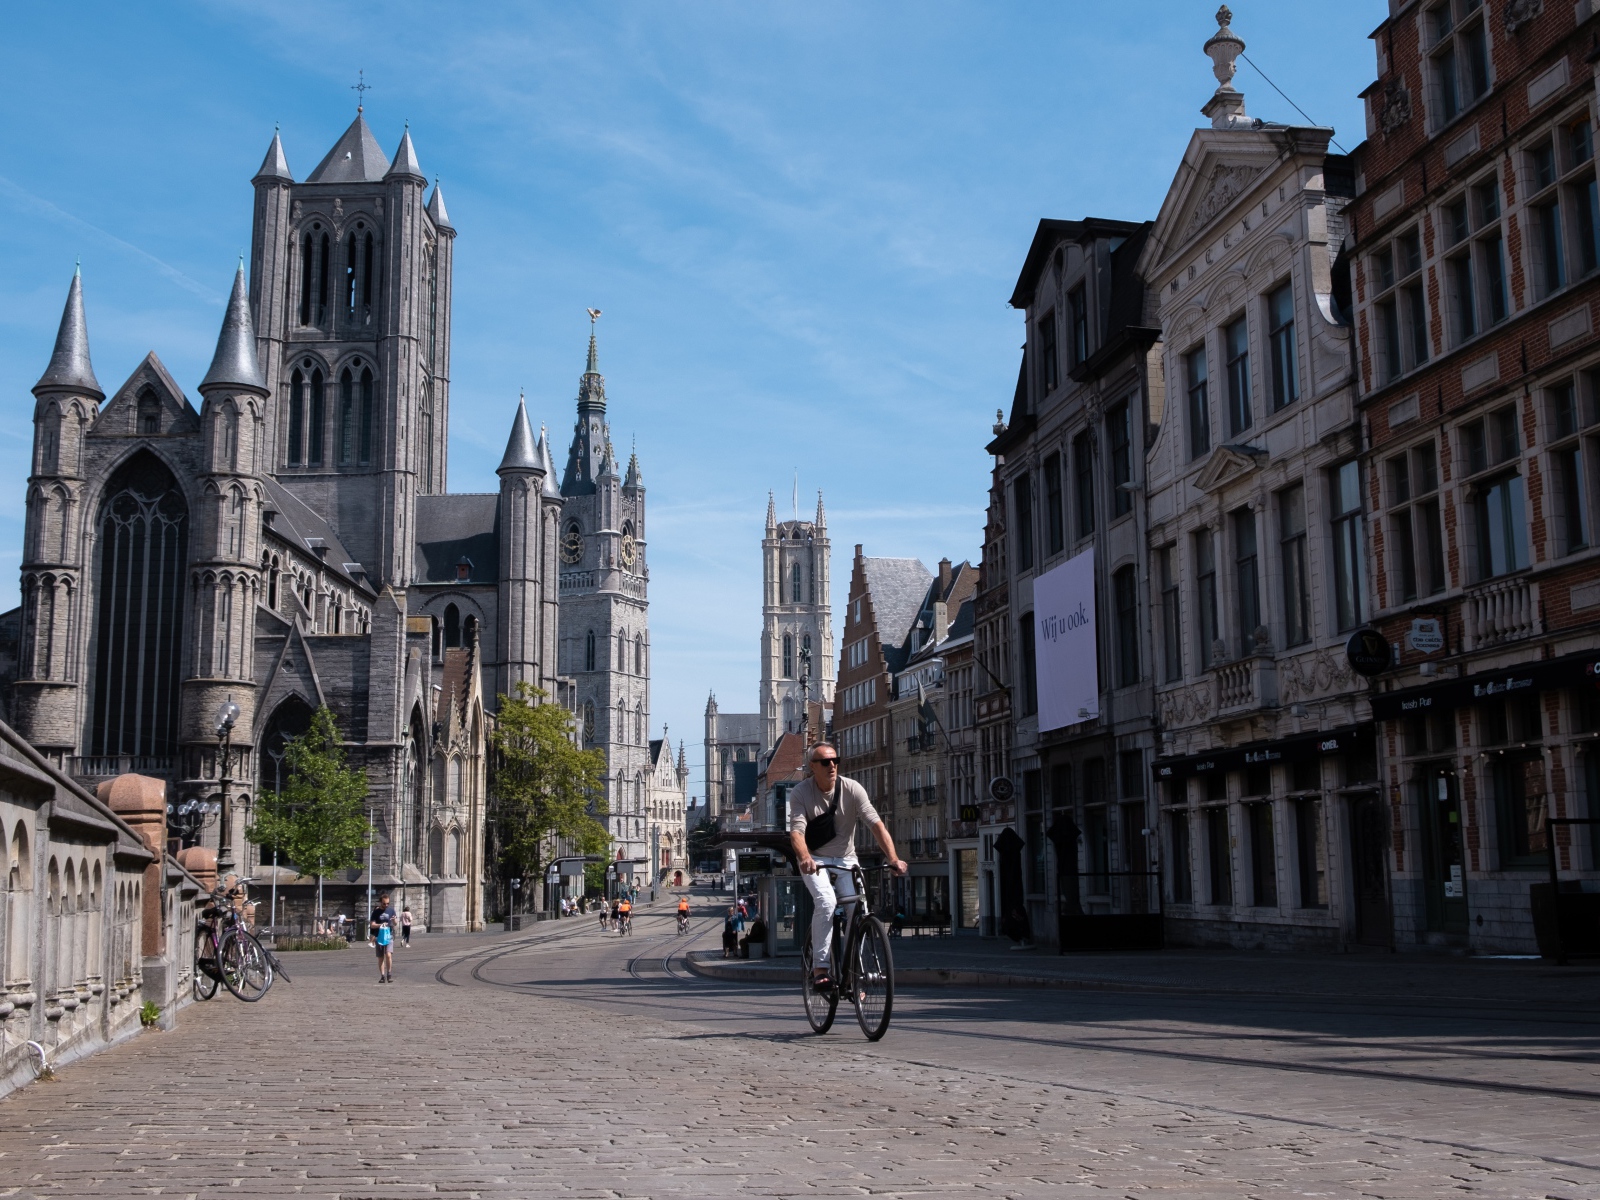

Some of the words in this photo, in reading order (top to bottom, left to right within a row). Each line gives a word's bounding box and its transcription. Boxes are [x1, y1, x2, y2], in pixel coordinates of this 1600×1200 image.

[1041, 615, 1057, 643] Wij
[1059, 618, 1066, 634] u
[1067, 601, 1089, 631] ook.
[1355, 655, 1386, 664] GUINN
